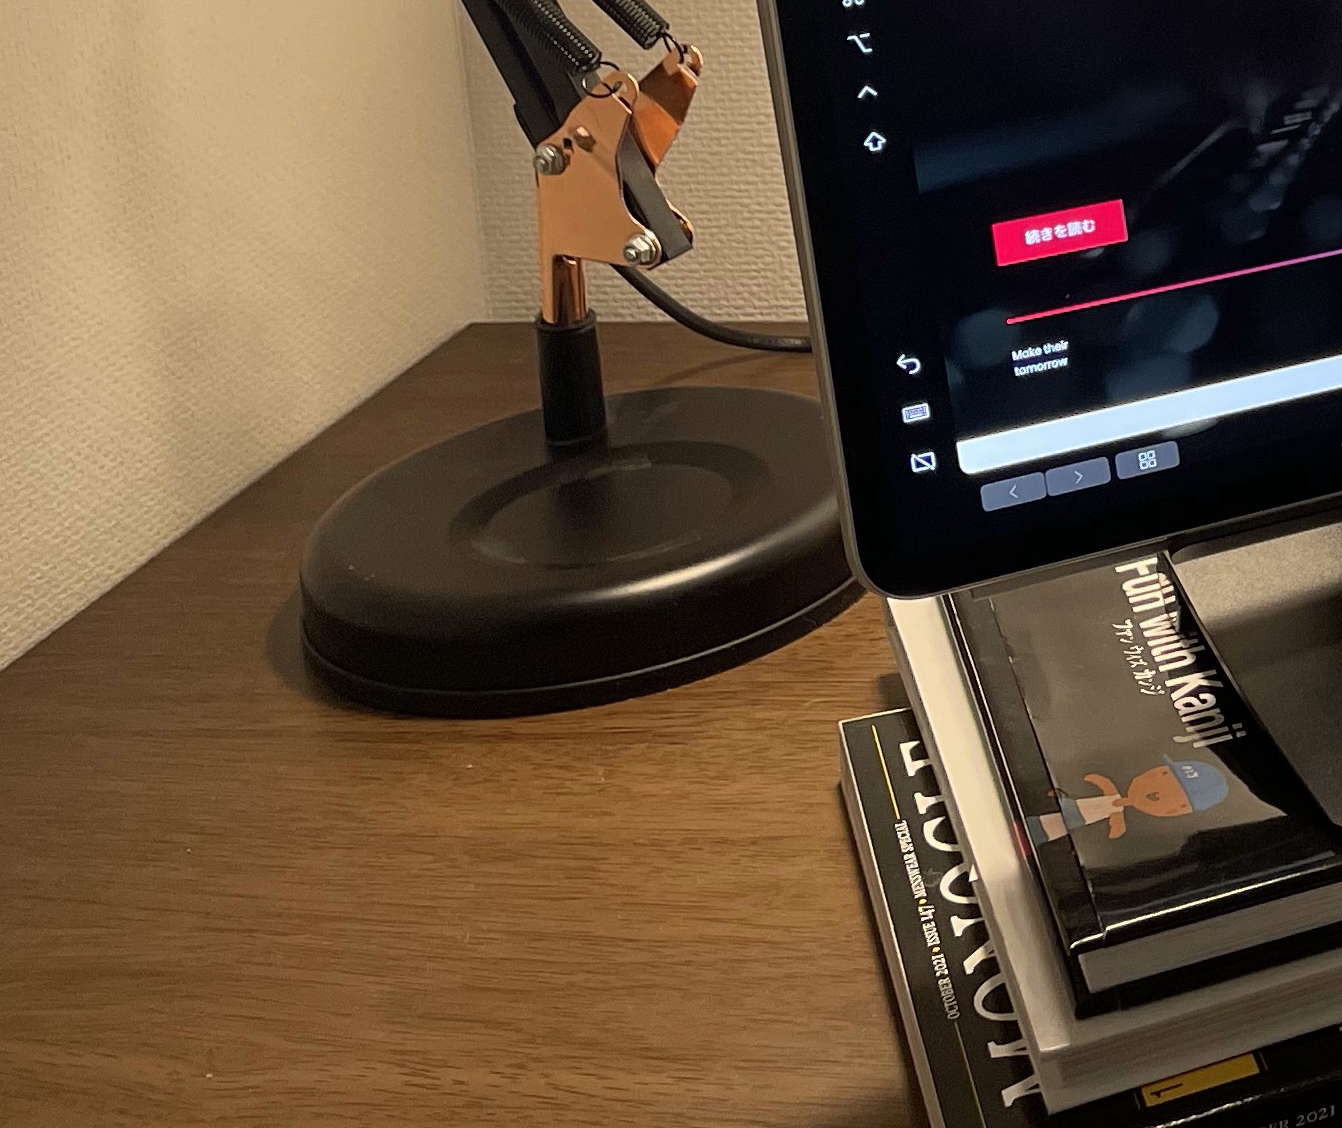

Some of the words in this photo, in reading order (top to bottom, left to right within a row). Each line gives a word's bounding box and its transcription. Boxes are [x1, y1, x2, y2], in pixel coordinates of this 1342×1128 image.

[1024, 219, 1097, 245] 続きを読む
[1011, 344, 1043, 362] Make
[1043, 339, 1069, 356] their
[1013, 356, 1068, 377] tomorrow
[1114, 556, 1177, 613] Fun
[1139, 610, 1206, 672] with
[1164, 669, 1247, 749] Kanji
[931, 953, 949, 977] 2021
[938, 975, 961, 1020] OCTOBER
[1295, 1104, 1336, 1128] 2021
